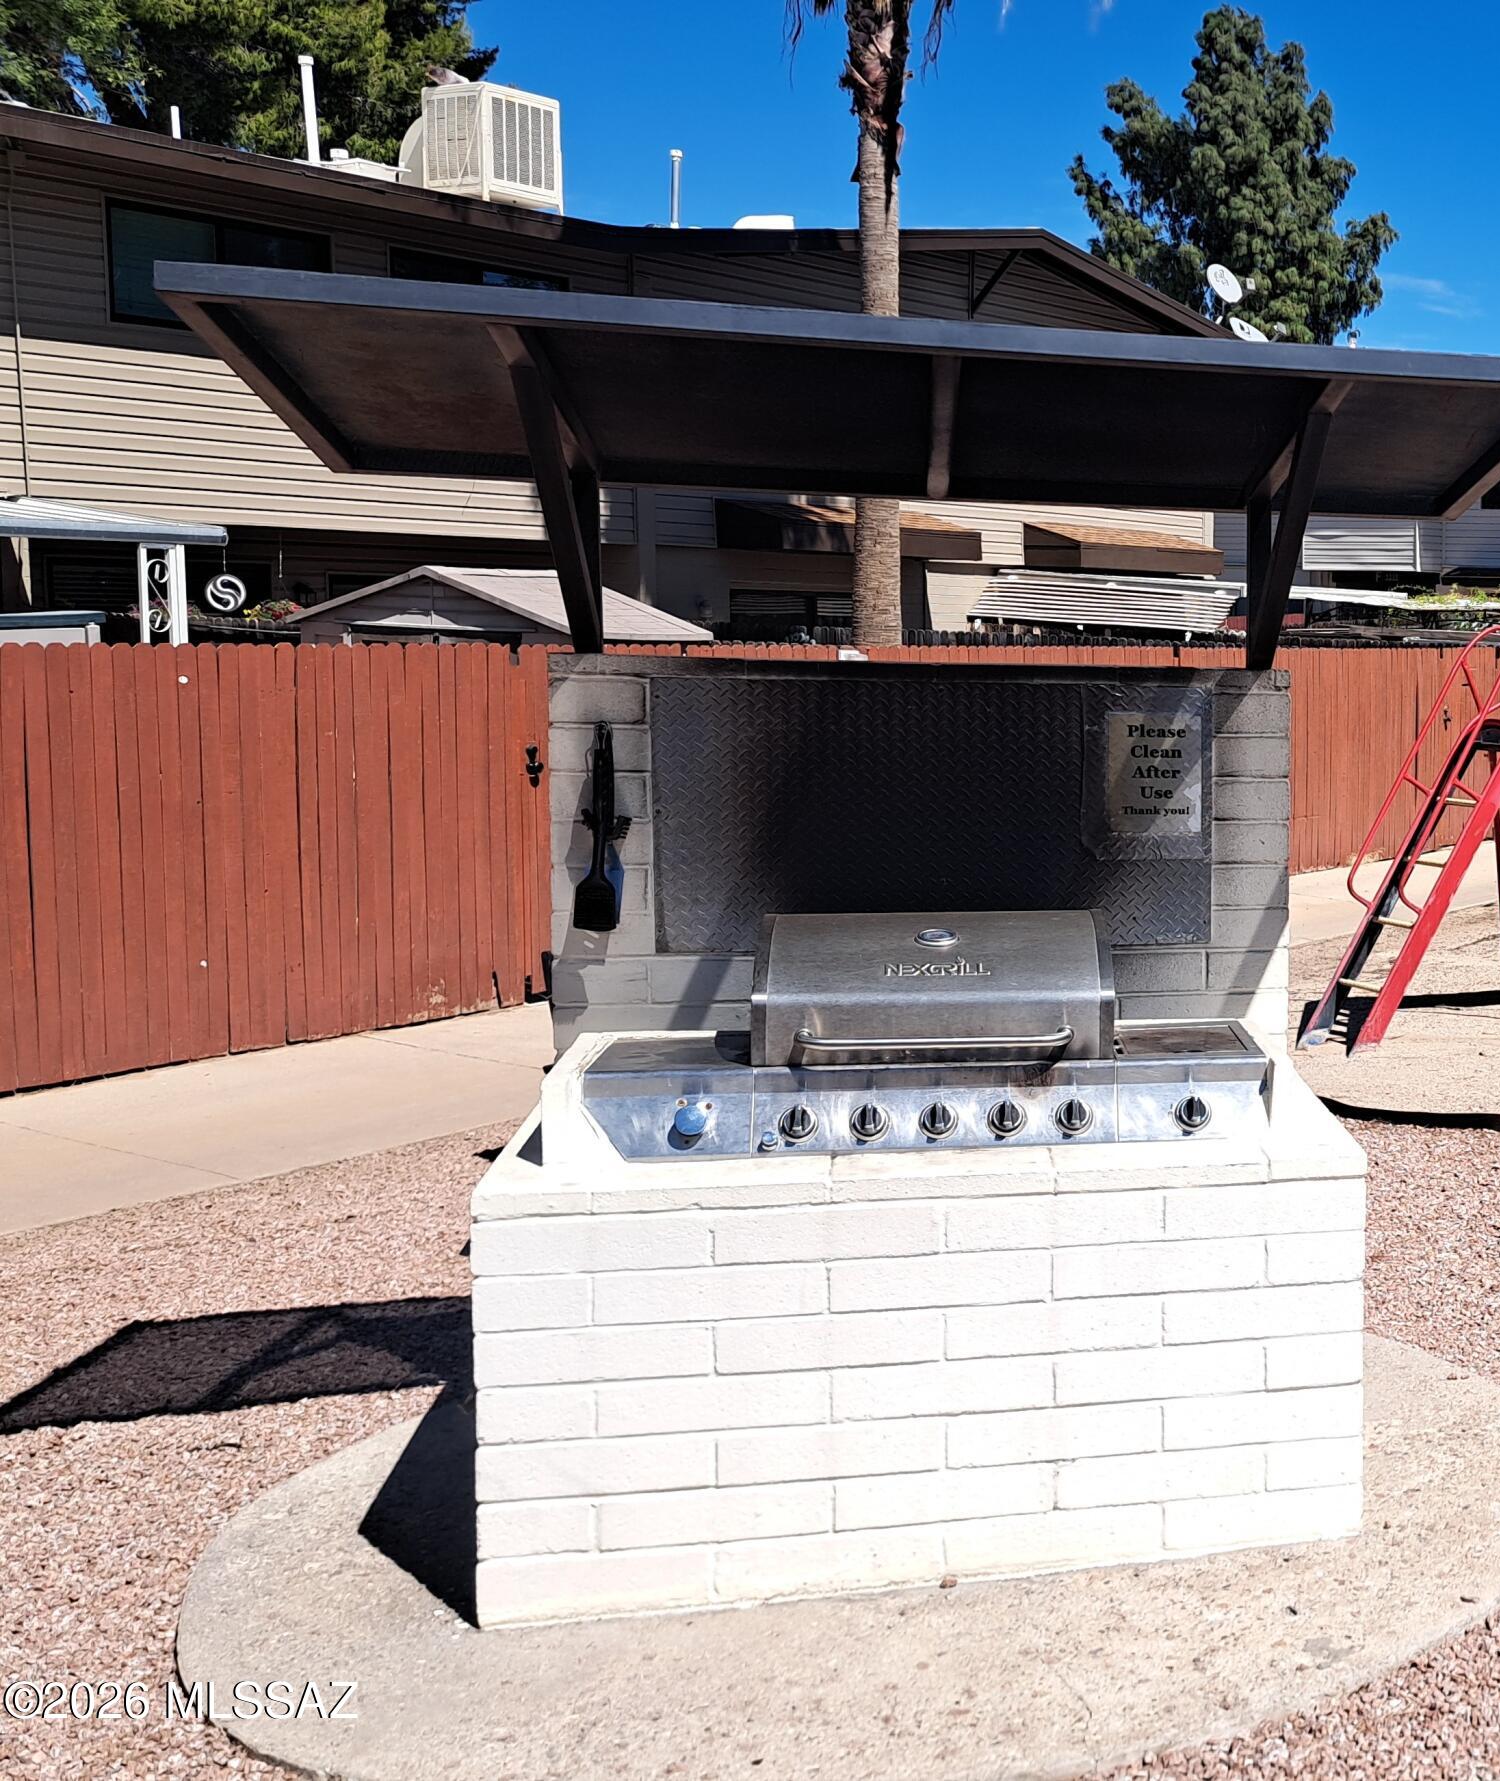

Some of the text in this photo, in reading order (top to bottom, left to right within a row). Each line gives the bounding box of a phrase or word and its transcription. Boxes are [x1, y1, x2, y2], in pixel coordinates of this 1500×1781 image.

[1127, 724, 1186, 738] Please
[1130, 745, 1182, 759] Clean
[1132, 765, 1181, 779] After
[1140, 786, 1174, 799] Use
[1122, 806, 1190, 817] Thank you!
[884, 957, 991, 976] NEXGRILL
